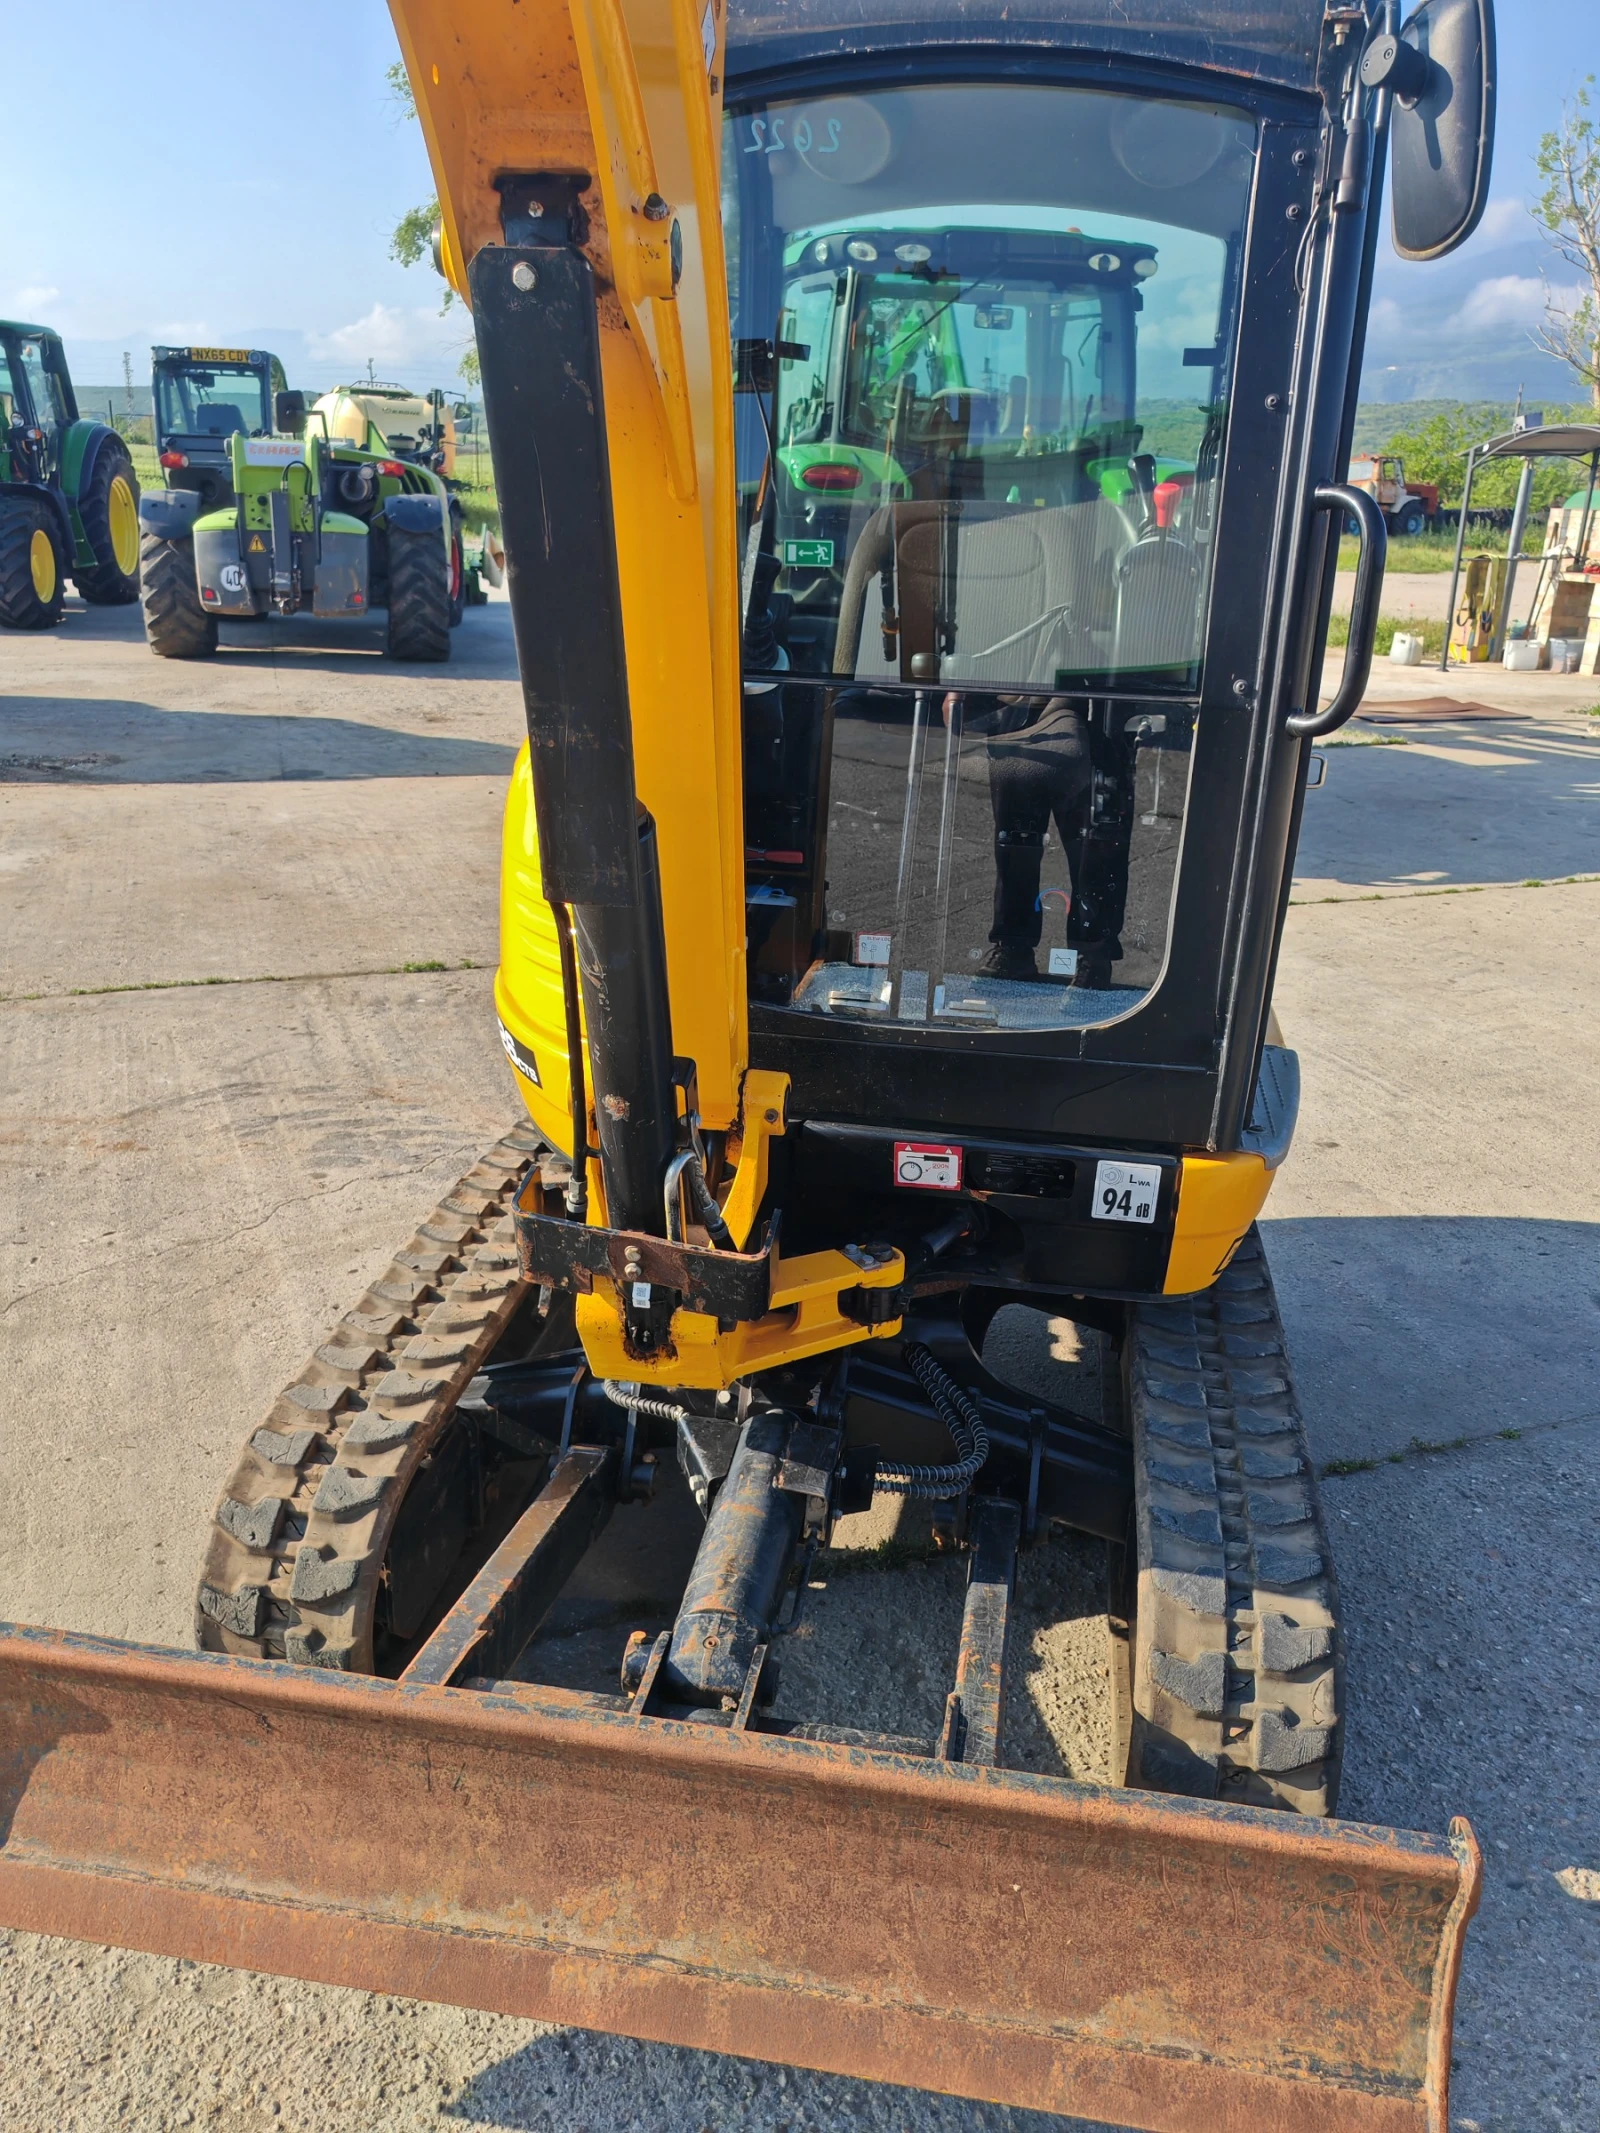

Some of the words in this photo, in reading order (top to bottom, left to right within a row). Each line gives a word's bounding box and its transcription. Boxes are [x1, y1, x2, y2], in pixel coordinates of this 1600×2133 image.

[196, 349, 226, 361] NX65
[249, 444, 301, 455] CLAAS
[226, 570, 241, 587] 40
[1103, 1188, 1133, 1217] 94
[1136, 1203, 1151, 1218] dB
